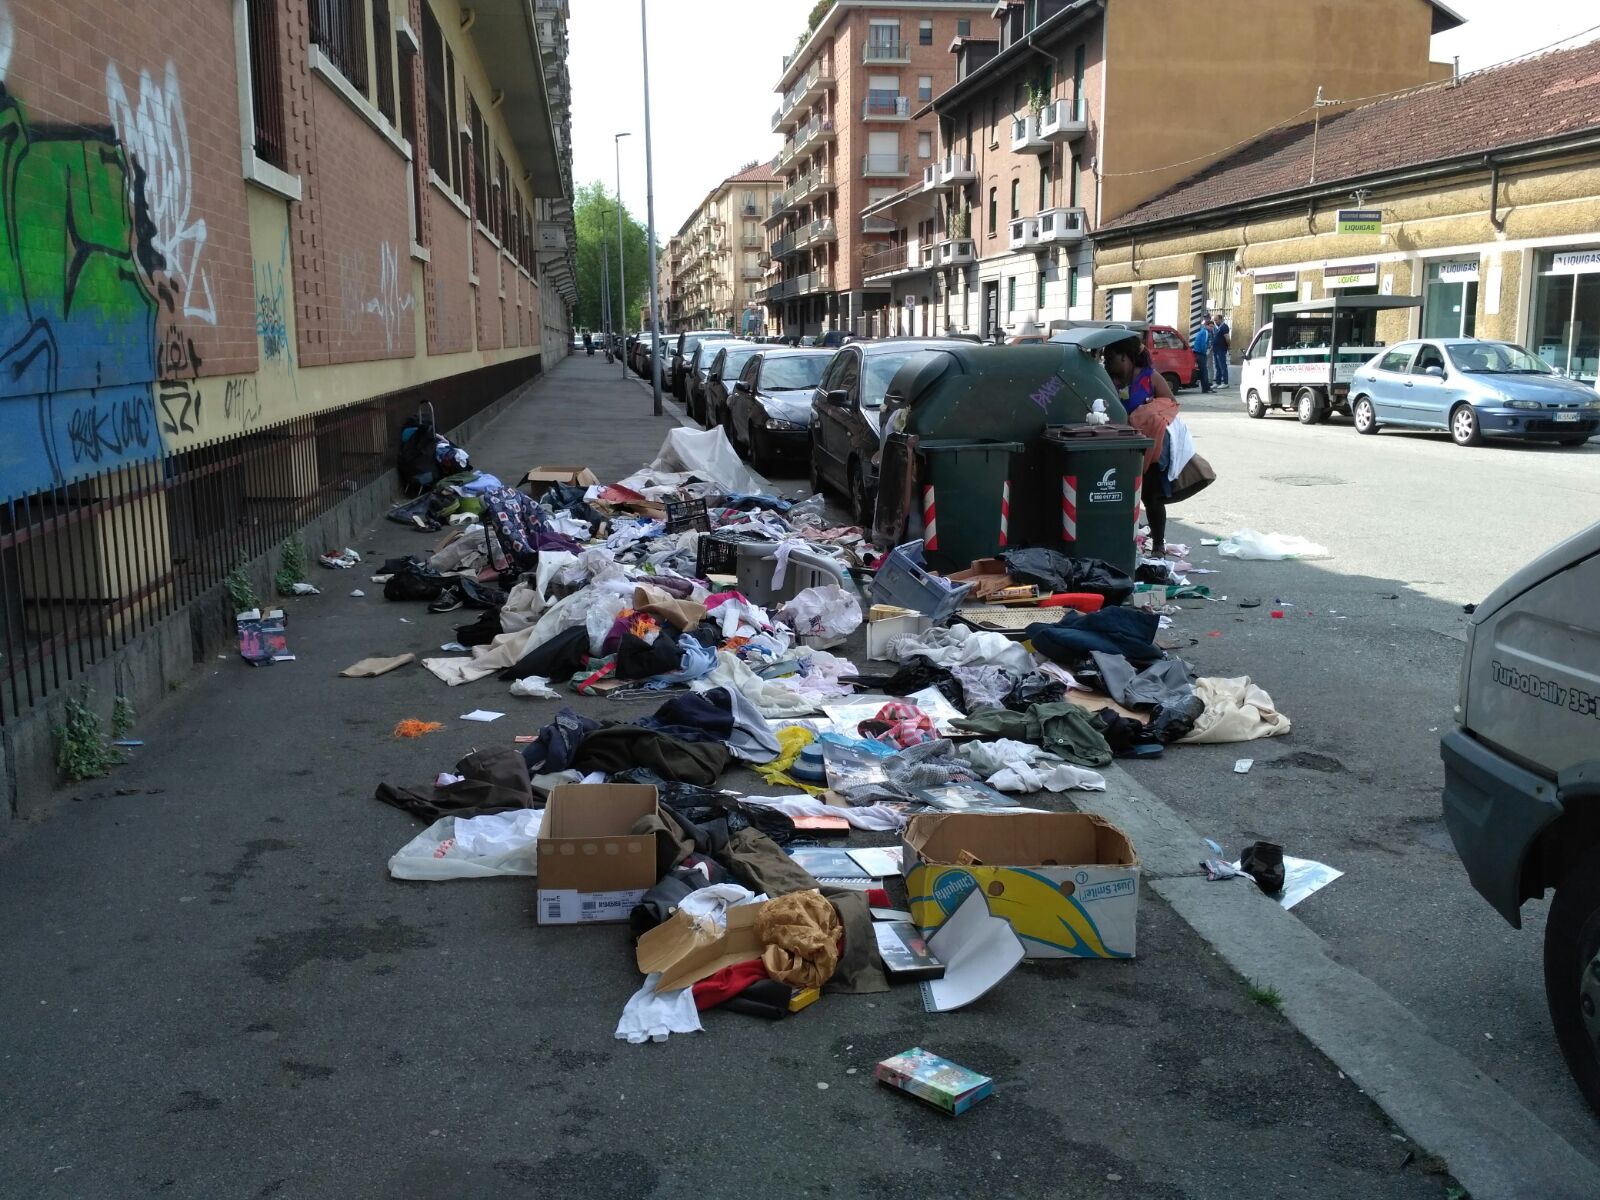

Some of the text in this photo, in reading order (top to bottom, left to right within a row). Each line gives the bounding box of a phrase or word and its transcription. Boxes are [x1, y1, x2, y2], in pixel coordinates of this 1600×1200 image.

[1344, 224, 1376, 232] LIQUIGAS
[1563, 254, 1600, 266] LIQUIGAS
[1446, 262, 1477, 274] LIQUIGAS
[1338, 275, 1360, 284] LIQUIGAS
[1265, 282, 1283, 291] LIQUIGAS
[1492, 660, 1567, 706] TurboDaily
[935, 874, 975, 900] Chiquita
[1112, 880, 1132, 893] Just
